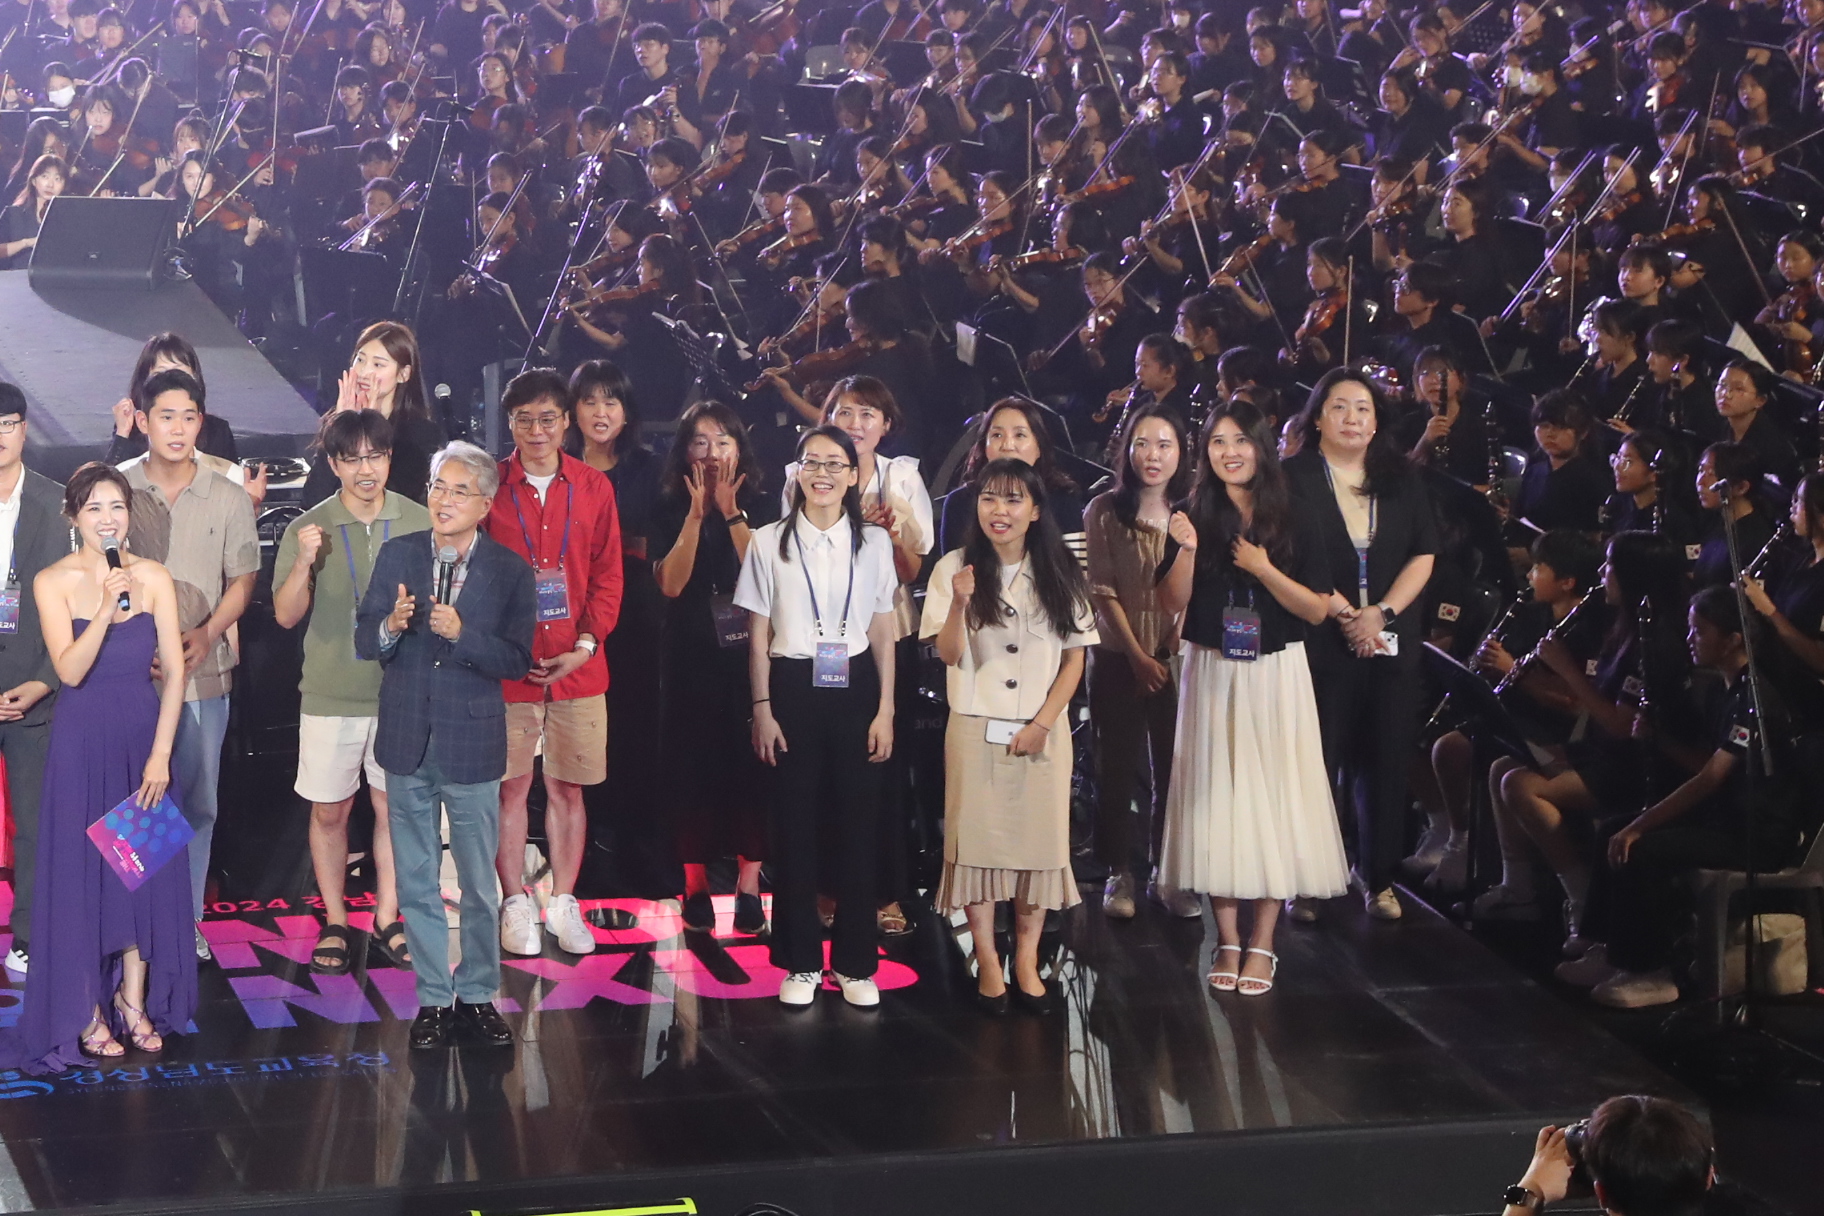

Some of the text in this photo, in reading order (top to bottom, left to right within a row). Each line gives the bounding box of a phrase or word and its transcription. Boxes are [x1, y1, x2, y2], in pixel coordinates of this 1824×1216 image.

[543, 607, 567, 617] 지도교사
[1229, 648, 1255, 658] 지도교사
[821, 673, 846, 683] 지도교사
